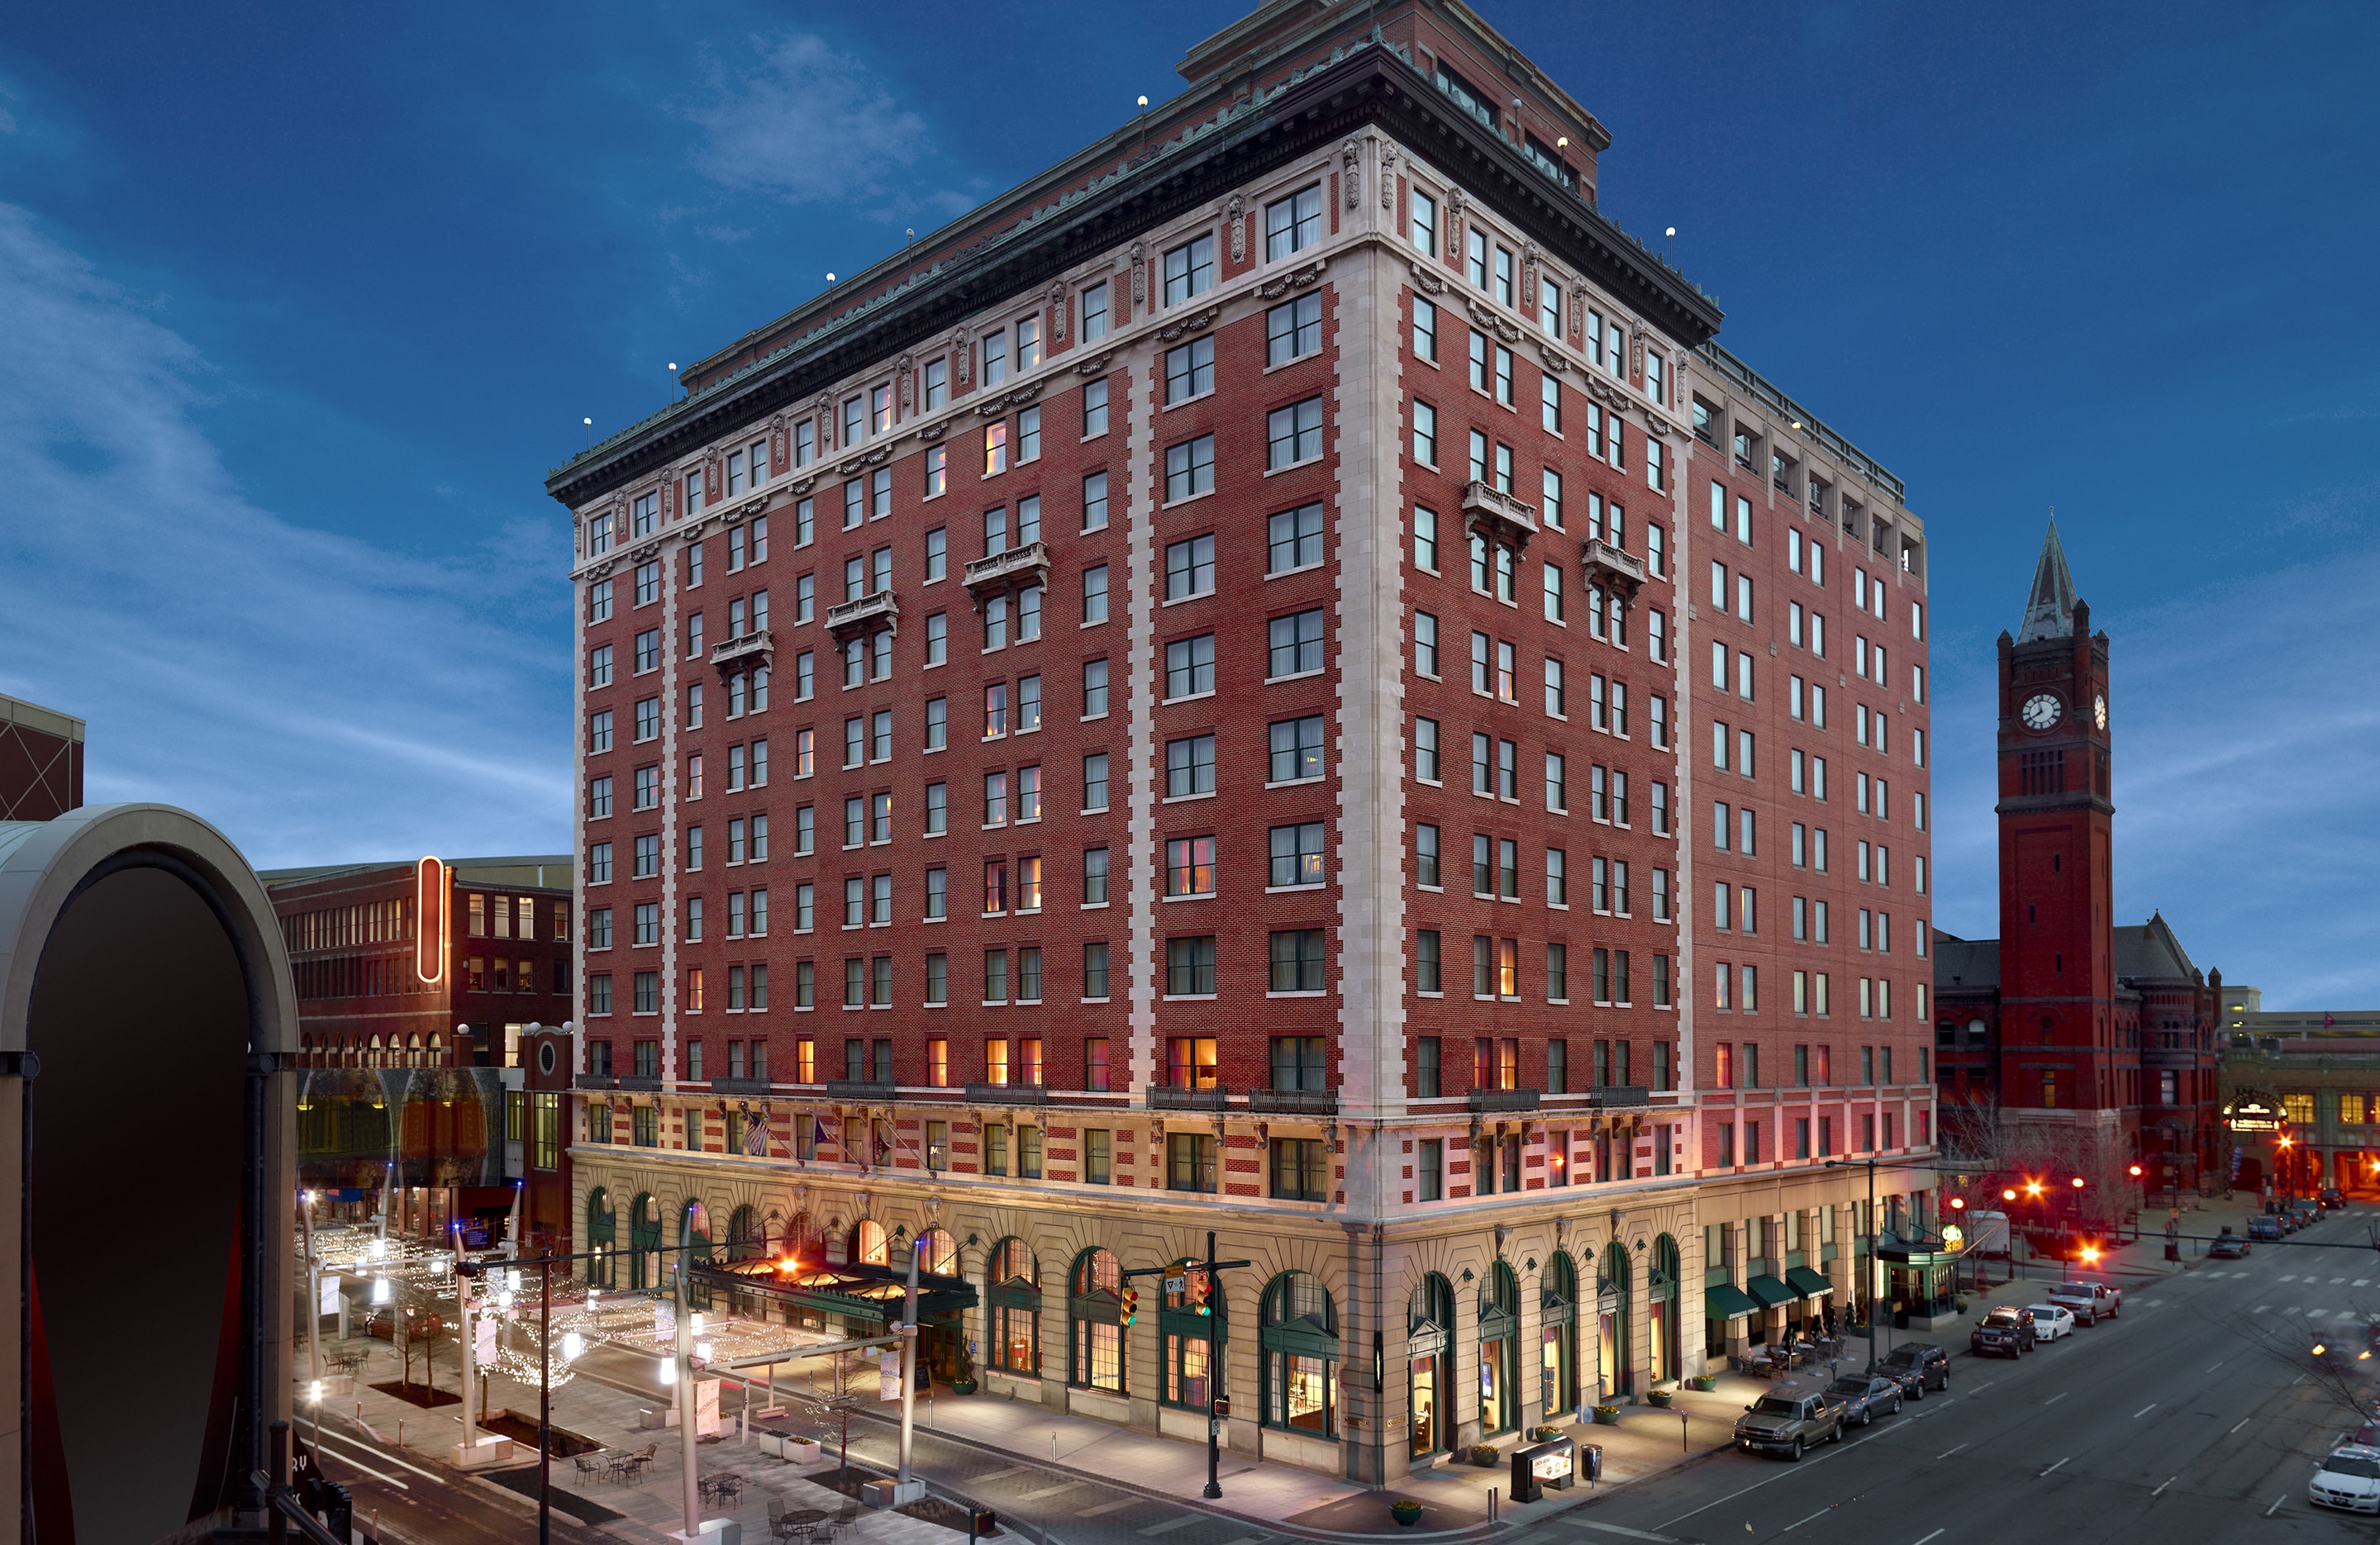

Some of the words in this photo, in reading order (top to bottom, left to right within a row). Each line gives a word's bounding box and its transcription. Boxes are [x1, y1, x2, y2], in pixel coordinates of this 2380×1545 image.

[1729, 1310, 1747, 1320] STARBUCKS
[1748, 1306, 1759, 1314] COFFEE
[697, 1395, 719, 1416] GEORGIA
